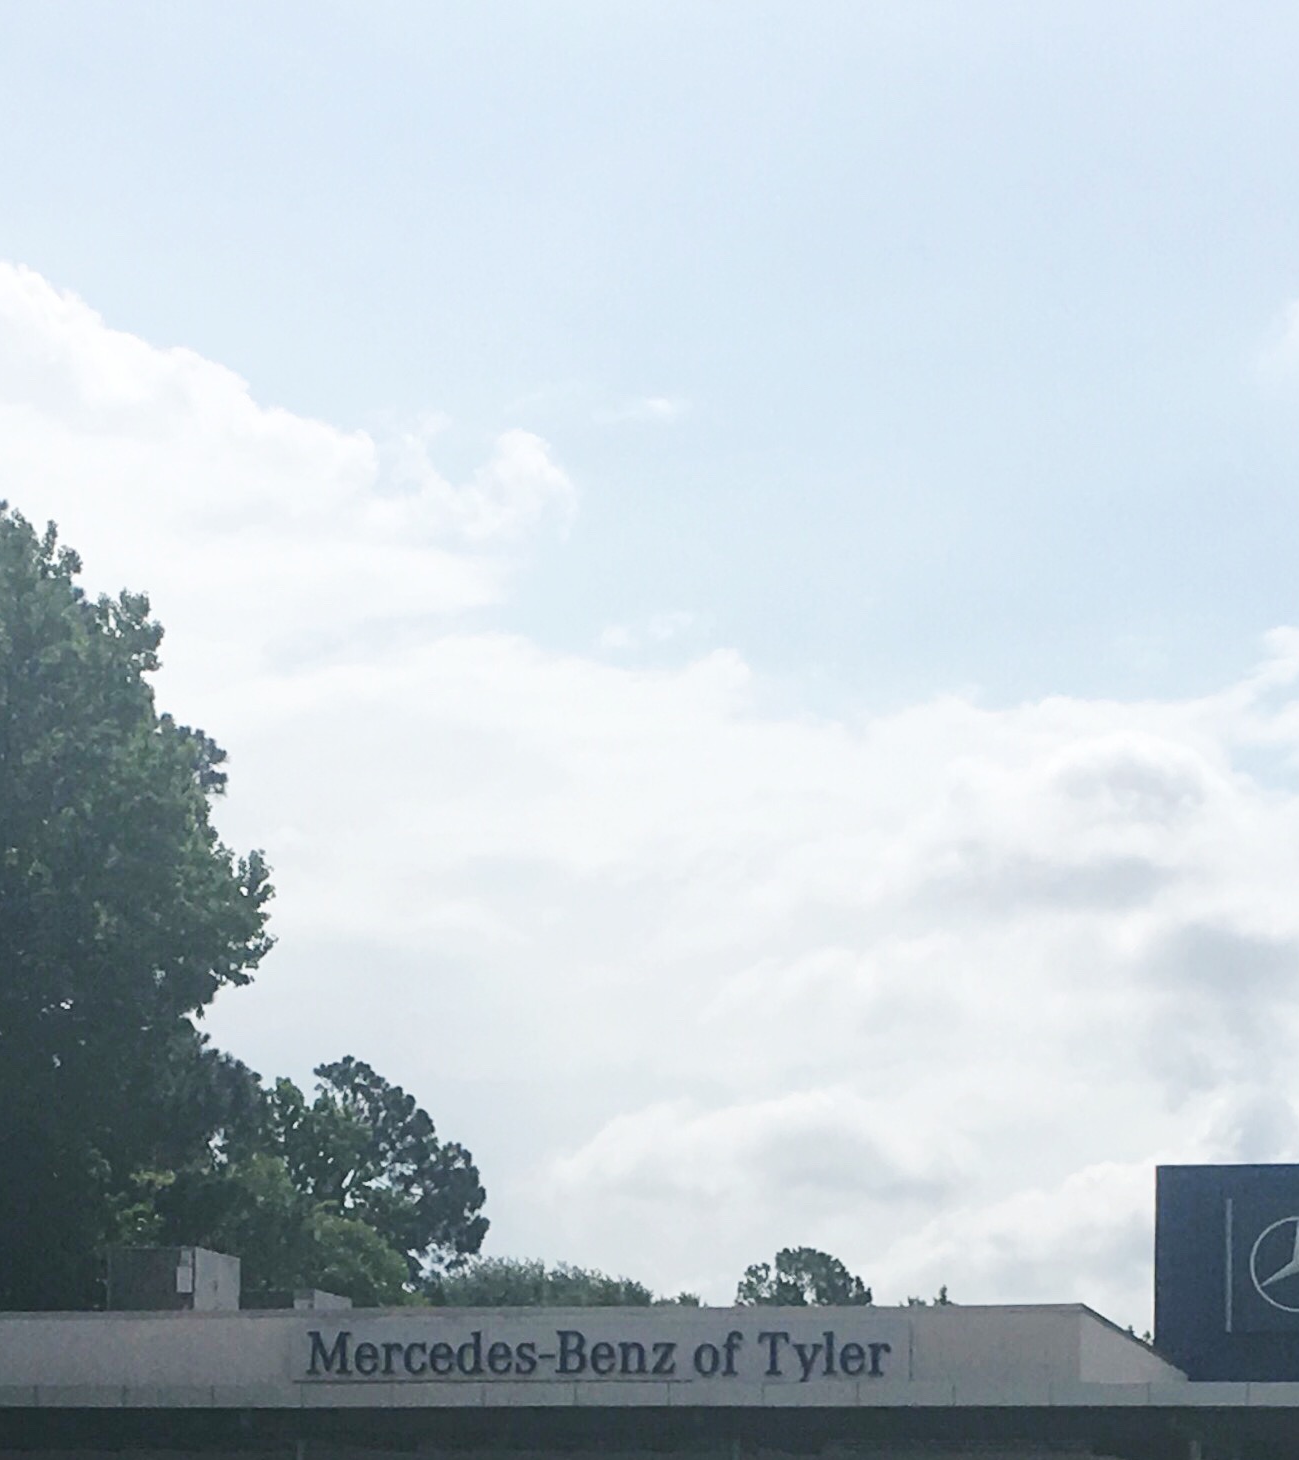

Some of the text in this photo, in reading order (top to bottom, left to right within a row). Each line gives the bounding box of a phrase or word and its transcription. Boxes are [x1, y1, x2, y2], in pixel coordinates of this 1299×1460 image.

[306, 1330, 890, 1381] Mercedes-Benz of Tyler
